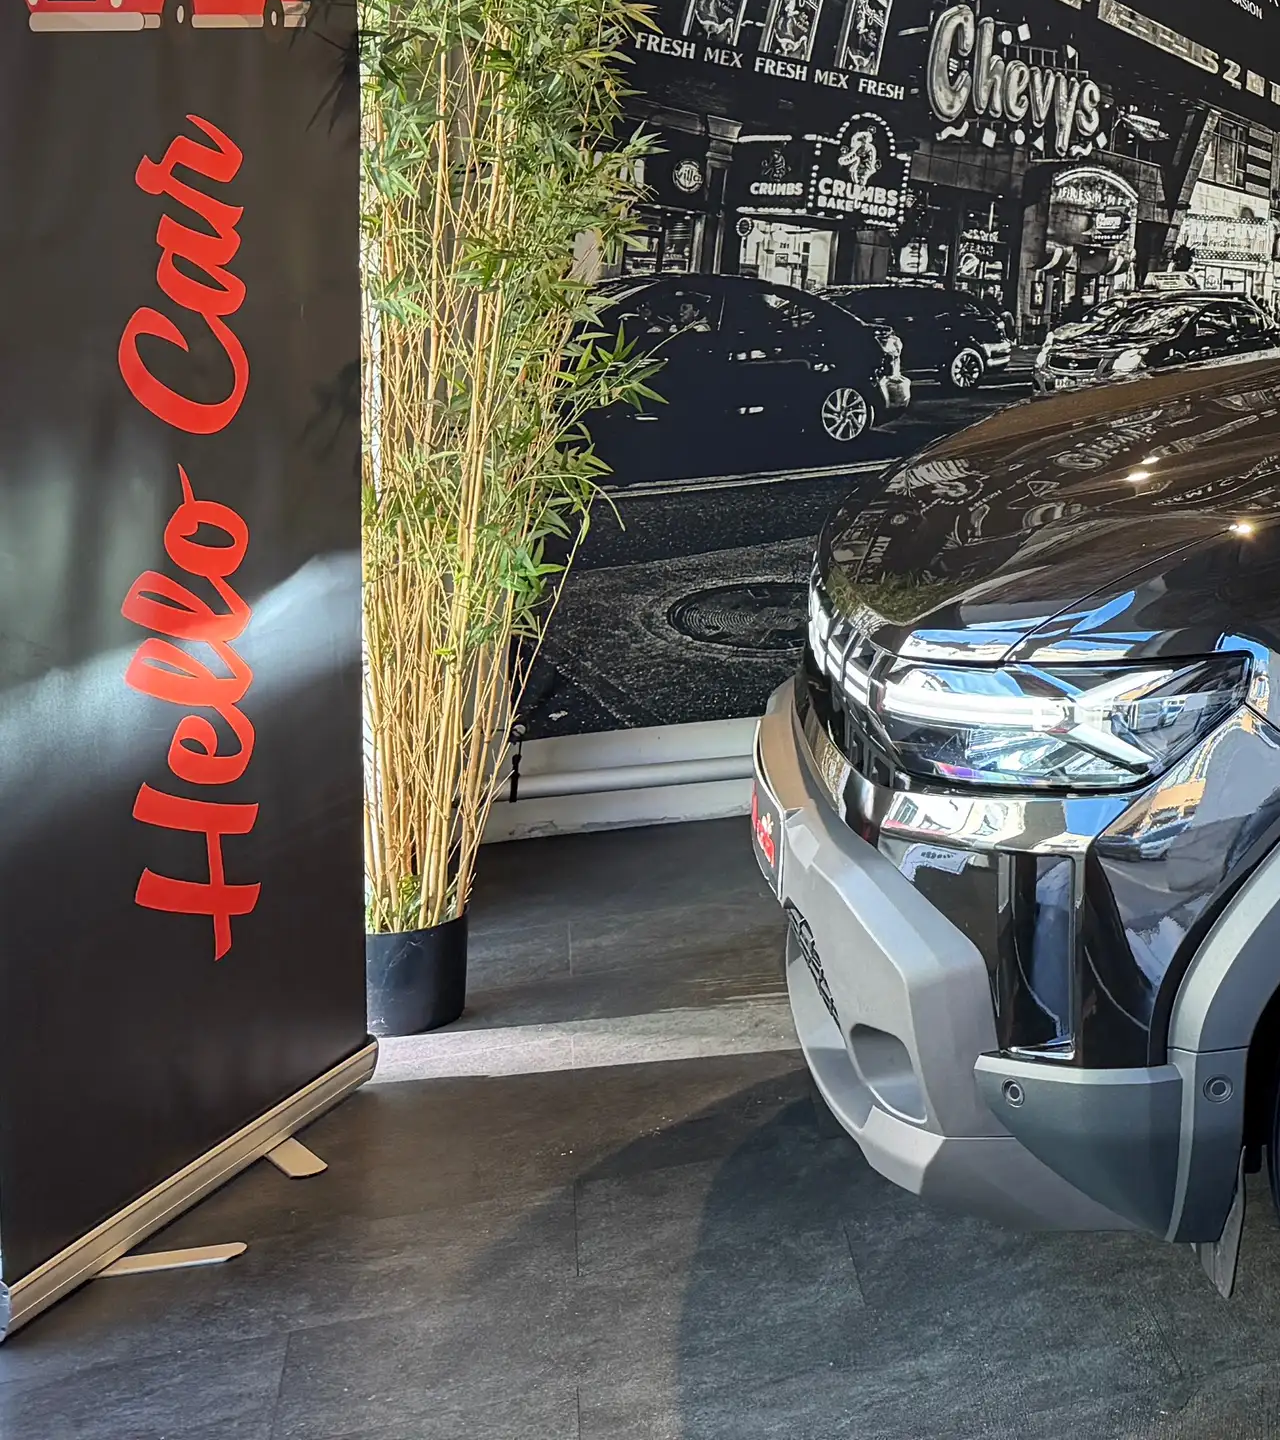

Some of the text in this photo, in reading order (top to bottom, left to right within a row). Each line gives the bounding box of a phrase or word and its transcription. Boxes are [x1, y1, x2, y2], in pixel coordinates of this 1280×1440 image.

[634, 31, 906, 101] FRESH MEX FRESH MEX FRESH
[927, 3, 1102, 157] Chevys
[749, 181, 804, 196] CRUMBS
[818, 177, 900, 208] CRUMBS
[118, 114, 262, 961] Hello Car
